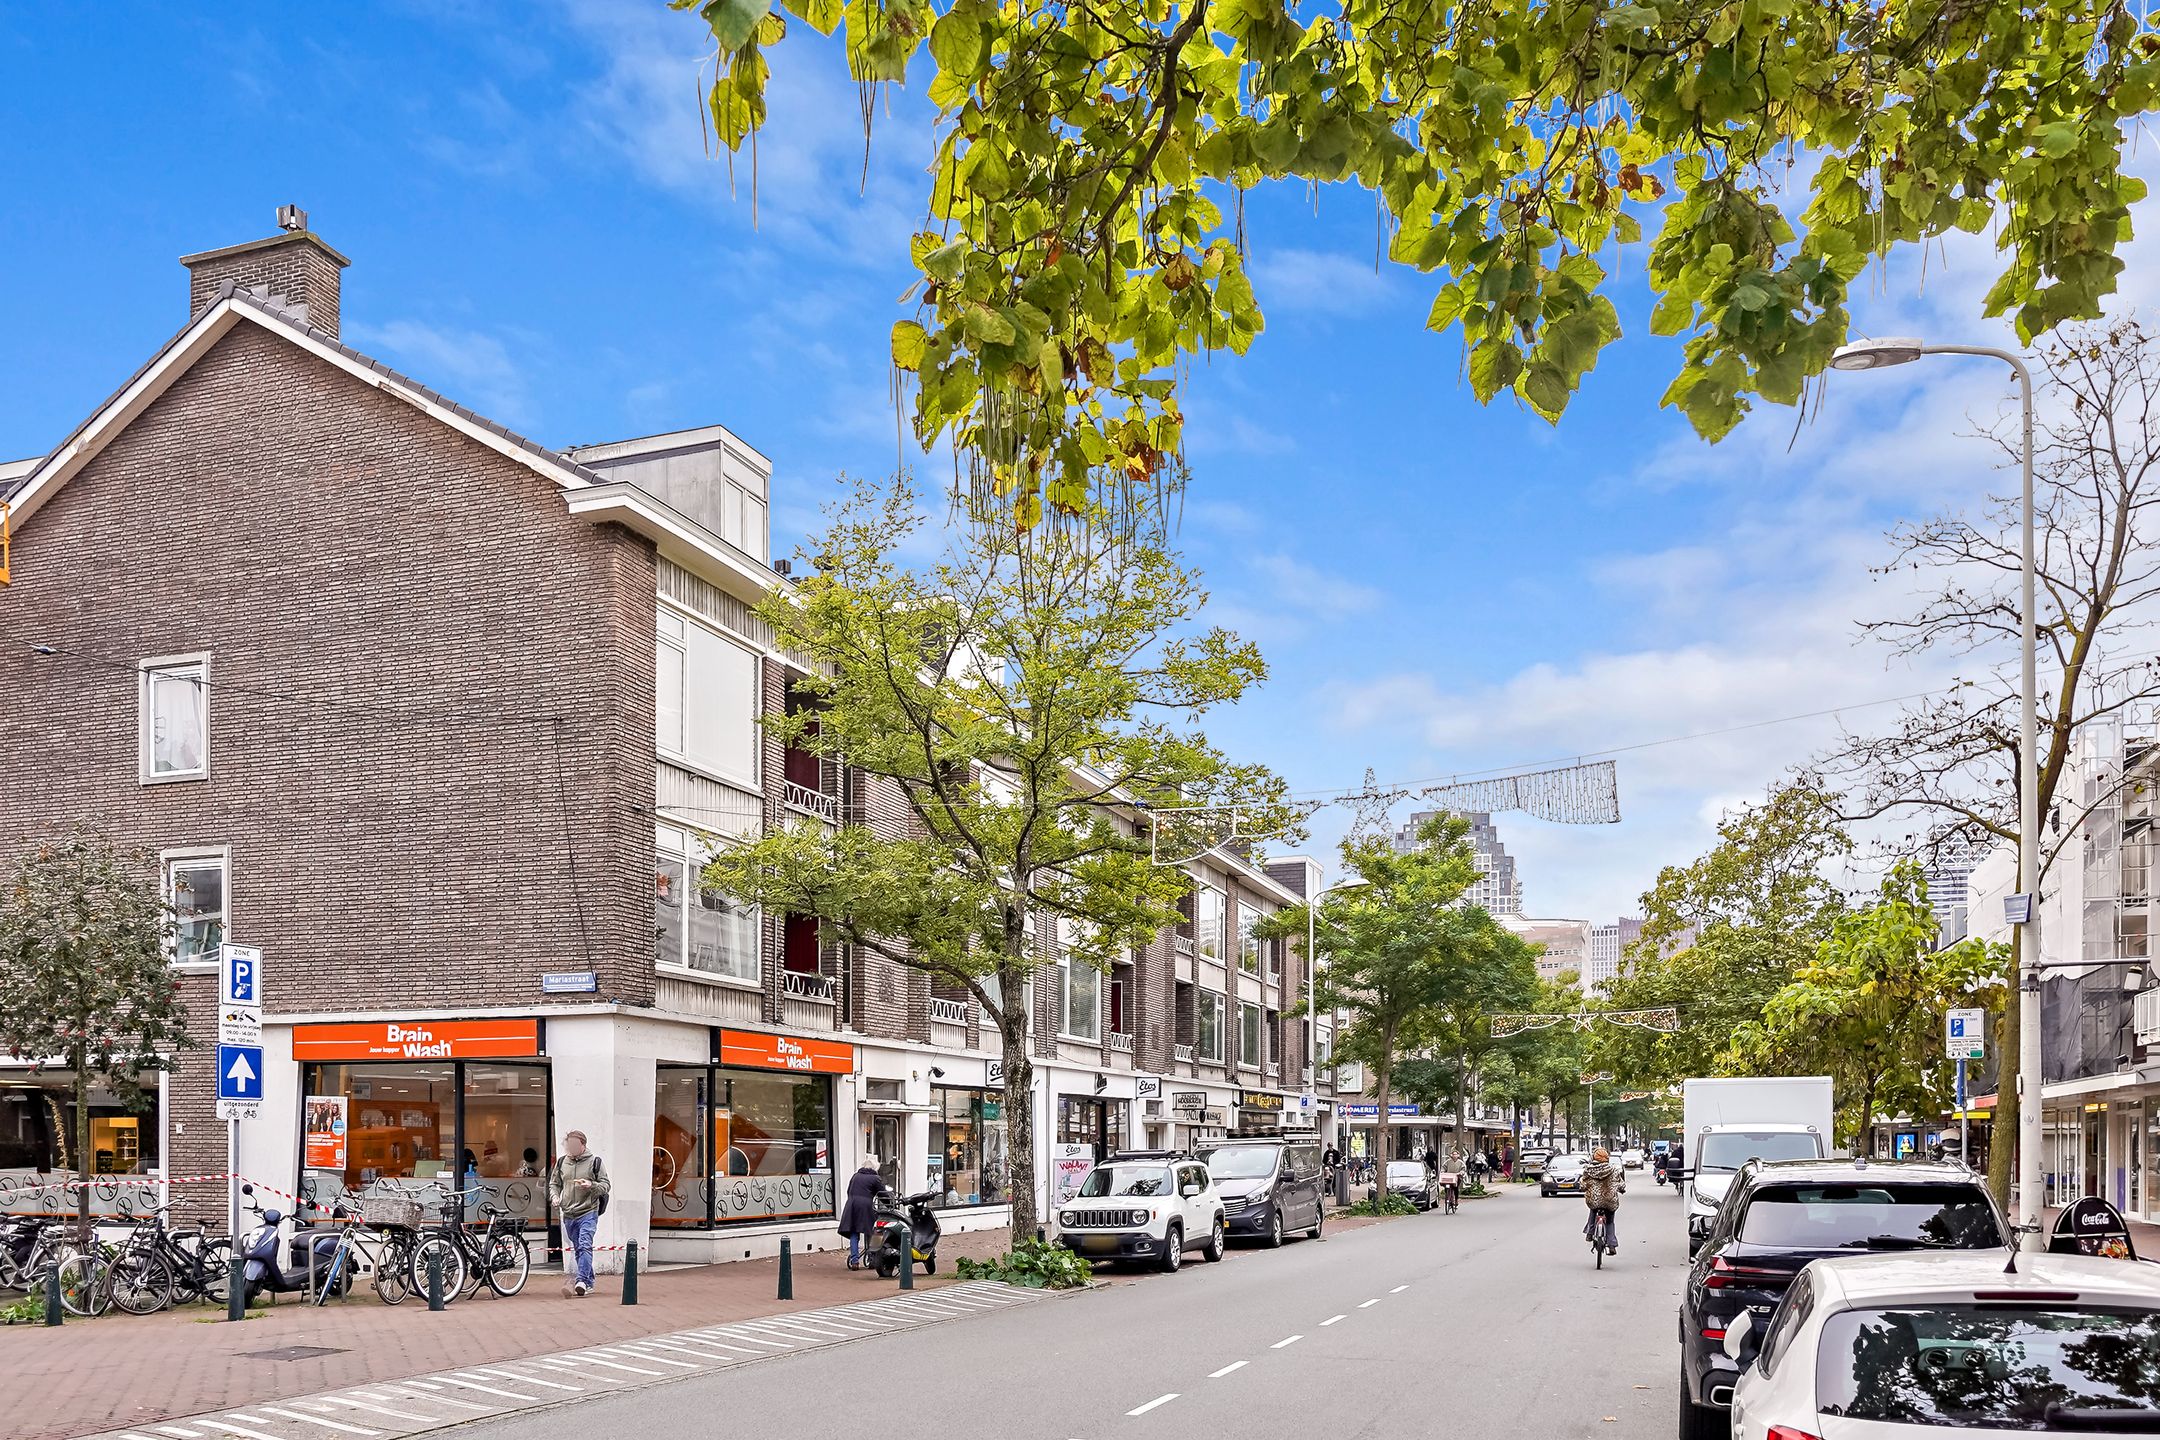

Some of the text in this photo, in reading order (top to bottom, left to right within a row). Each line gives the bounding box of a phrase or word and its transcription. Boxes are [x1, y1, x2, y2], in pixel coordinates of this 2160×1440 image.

[236, 962, 249, 984] P
[549, 976, 589, 984] Mariastraat
[1954, 1020, 1961, 1028] P
[387, 1024, 433, 1042] Brain
[403, 1040, 452, 1057] Wash
[777, 1037, 803, 1055] Brain
[786, 1055, 813, 1069] Wash
[990, 1064, 1004, 1081] Et
[1139, 1080, 1157, 1095] Etos
[1065, 1145, 1081, 1156] Etos
[1745, 1304, 1771, 1313] X5
